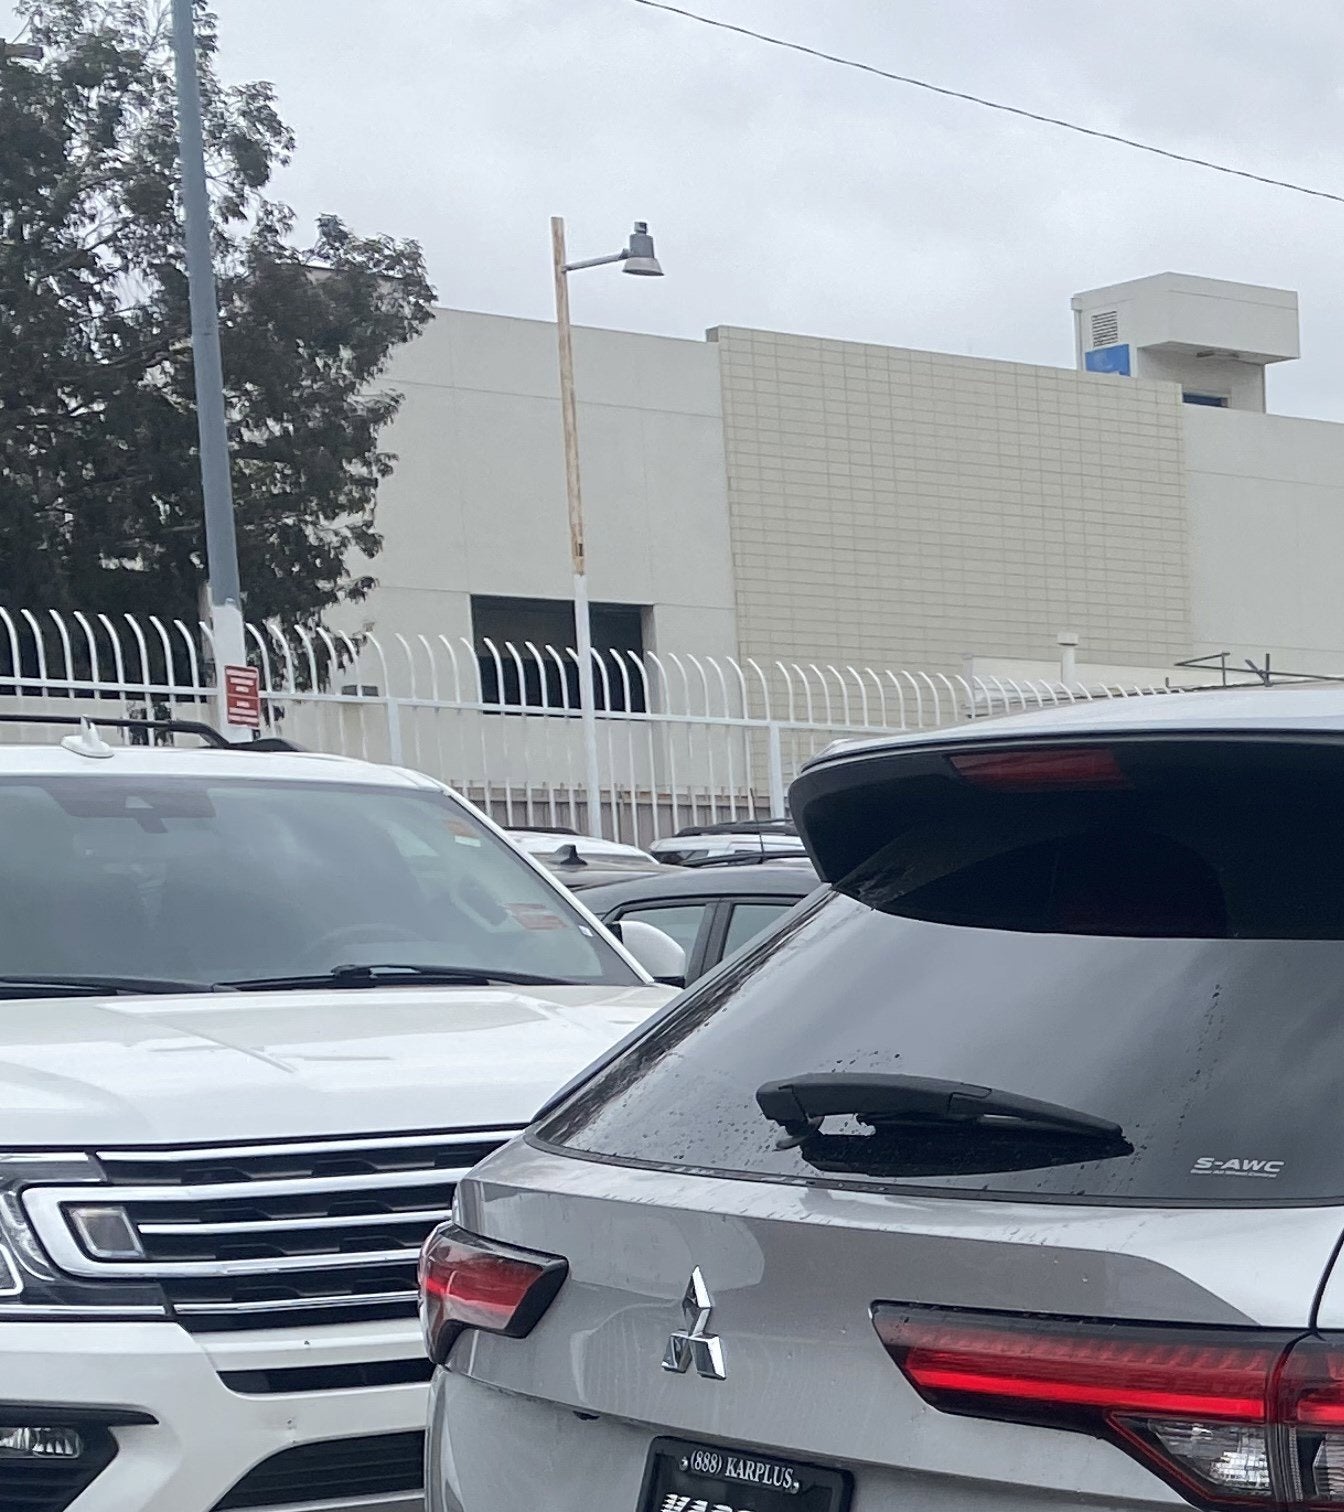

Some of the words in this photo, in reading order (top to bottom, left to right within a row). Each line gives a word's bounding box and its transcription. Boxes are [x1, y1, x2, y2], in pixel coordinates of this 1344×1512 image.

[1193, 1157, 1285, 1172] S-AWC
[690, 1450, 722, 1475] (888)
[725, 1457, 794, 1489] KARPLUS
